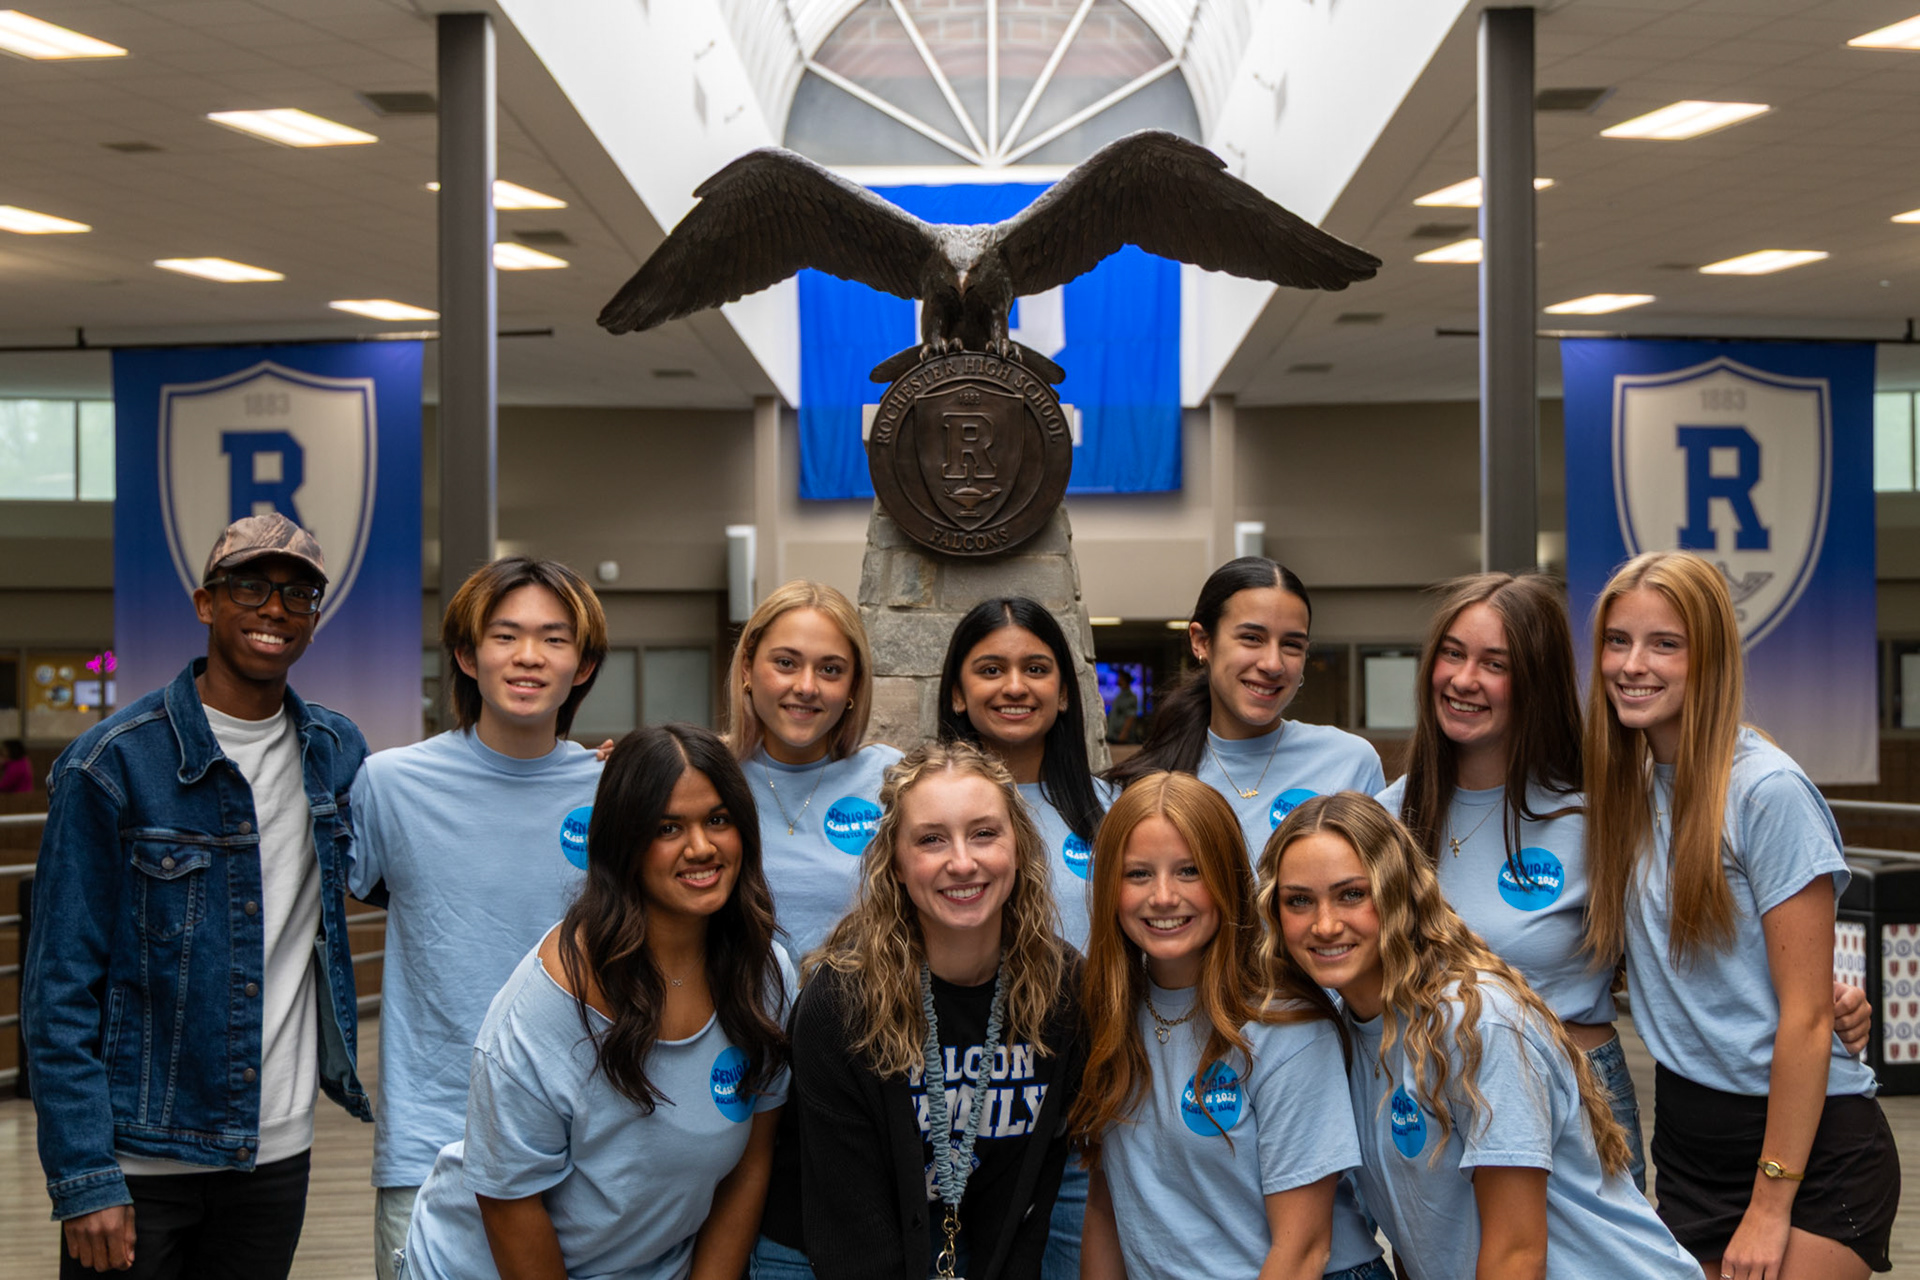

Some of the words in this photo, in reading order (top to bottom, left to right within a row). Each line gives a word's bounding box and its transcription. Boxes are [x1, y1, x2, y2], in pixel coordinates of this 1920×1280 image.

[244, 393, 291, 416] 1883
[877, 361, 957, 447] ROCHESTER
[964, 357, 1012, 378] HIGH
[1014, 374, 1065, 443] SCHOOL
[1700, 388, 1747, 411] 1883
[942, 411, 997, 479] R
[220, 430, 315, 534] R
[1675, 424, 1771, 551] R
[929, 527, 1010, 549] FALCONS
[1215, 1092, 1237, 1103] 2025
